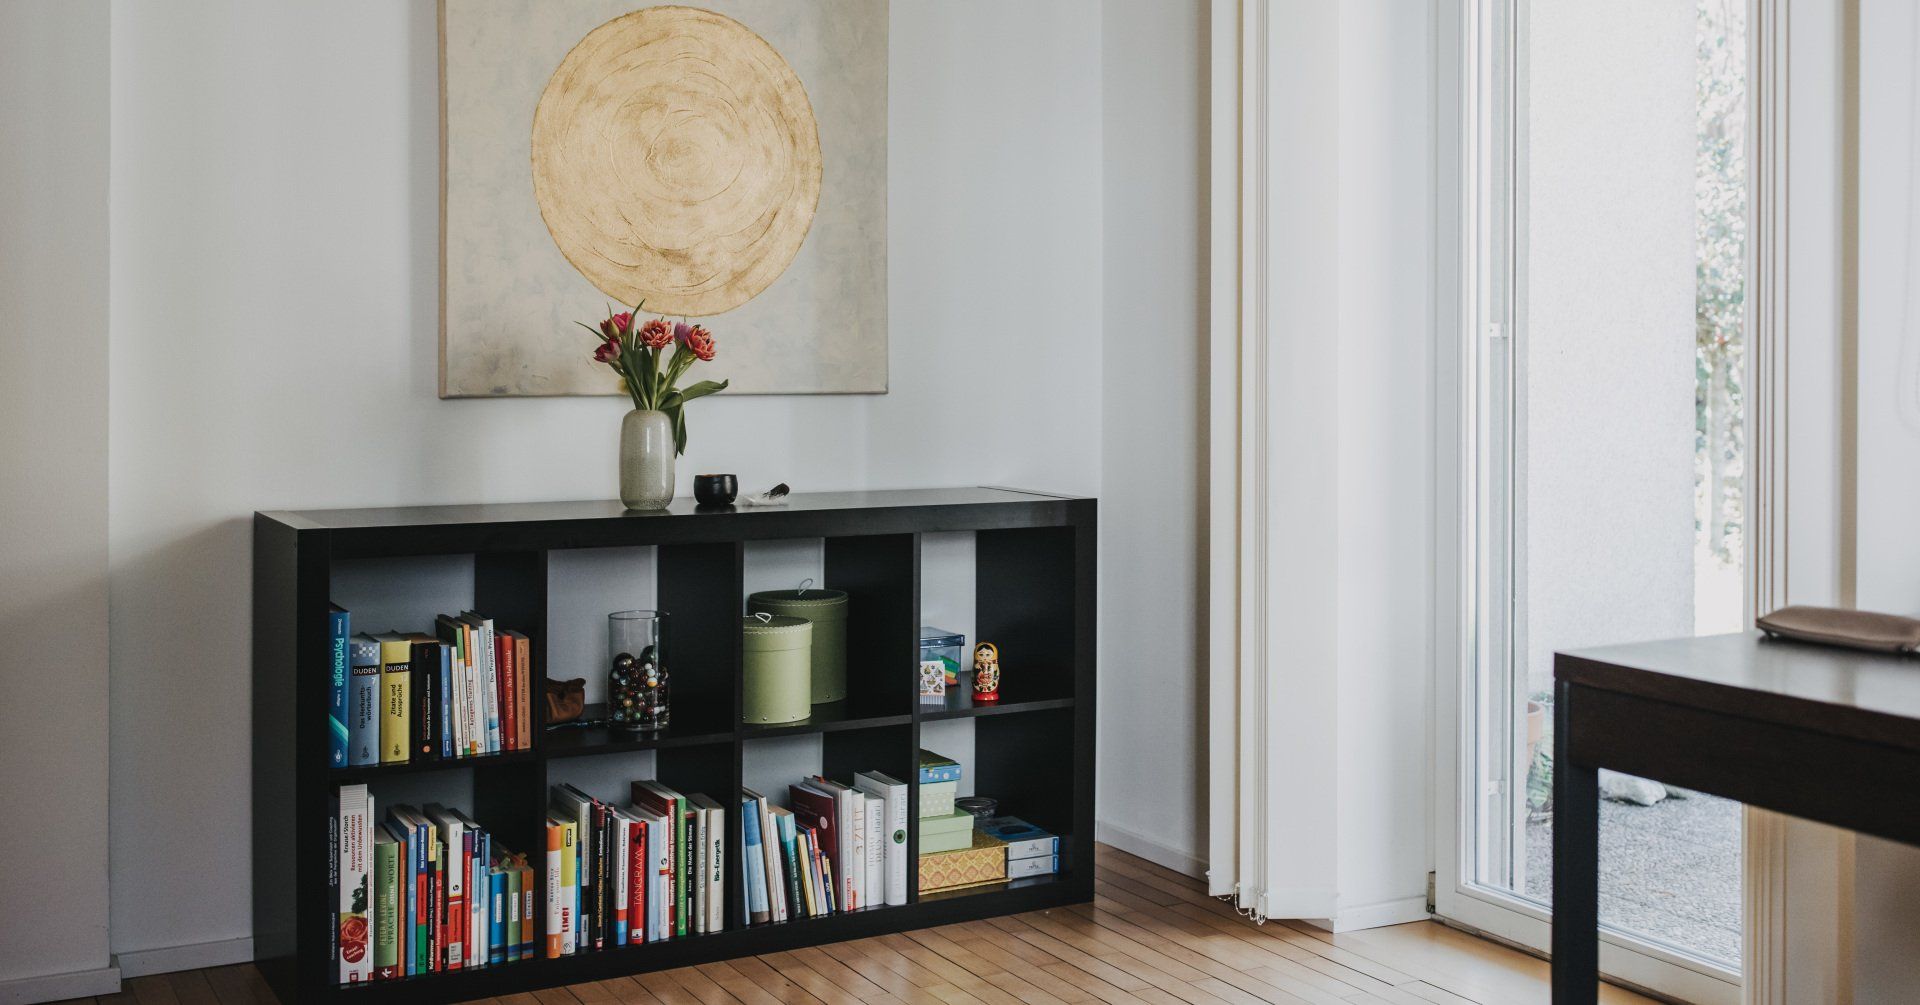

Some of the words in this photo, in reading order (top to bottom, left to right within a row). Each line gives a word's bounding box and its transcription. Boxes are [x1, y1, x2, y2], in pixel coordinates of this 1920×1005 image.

[334, 637, 345, 687] Psychologie
[353, 667, 377, 676] DUDEN
[386, 664, 409, 672] DUDEN
[633, 848, 643, 907] TANGRAM
[379, 894, 387, 917] LEVINE
[379, 925, 387, 946] PETER
[388, 907, 396, 945] SPRACHE
